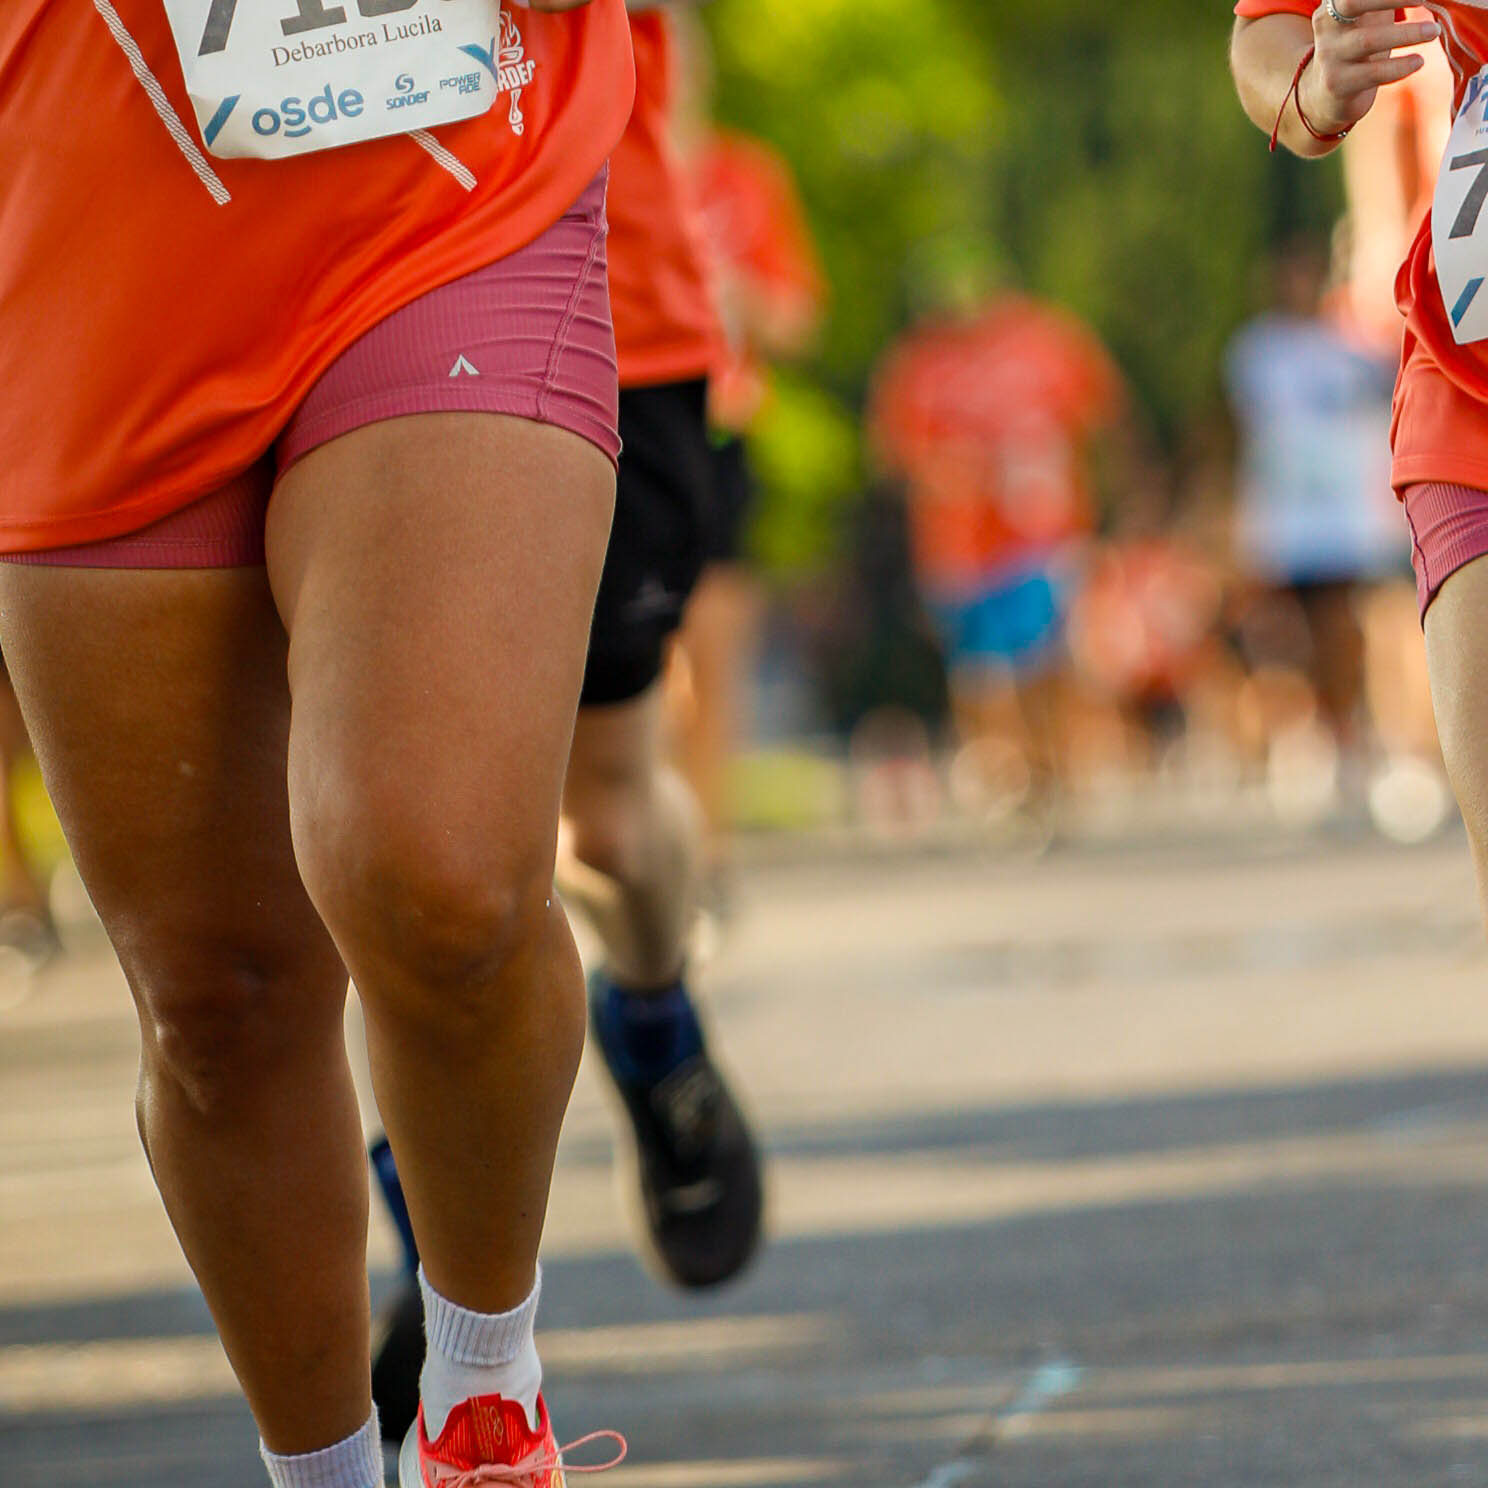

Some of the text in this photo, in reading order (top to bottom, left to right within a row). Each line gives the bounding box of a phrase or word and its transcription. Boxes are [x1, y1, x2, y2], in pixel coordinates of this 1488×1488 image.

[272, 14, 443, 67] Debarbora Lucila
[251, 83, 365, 139] osde
